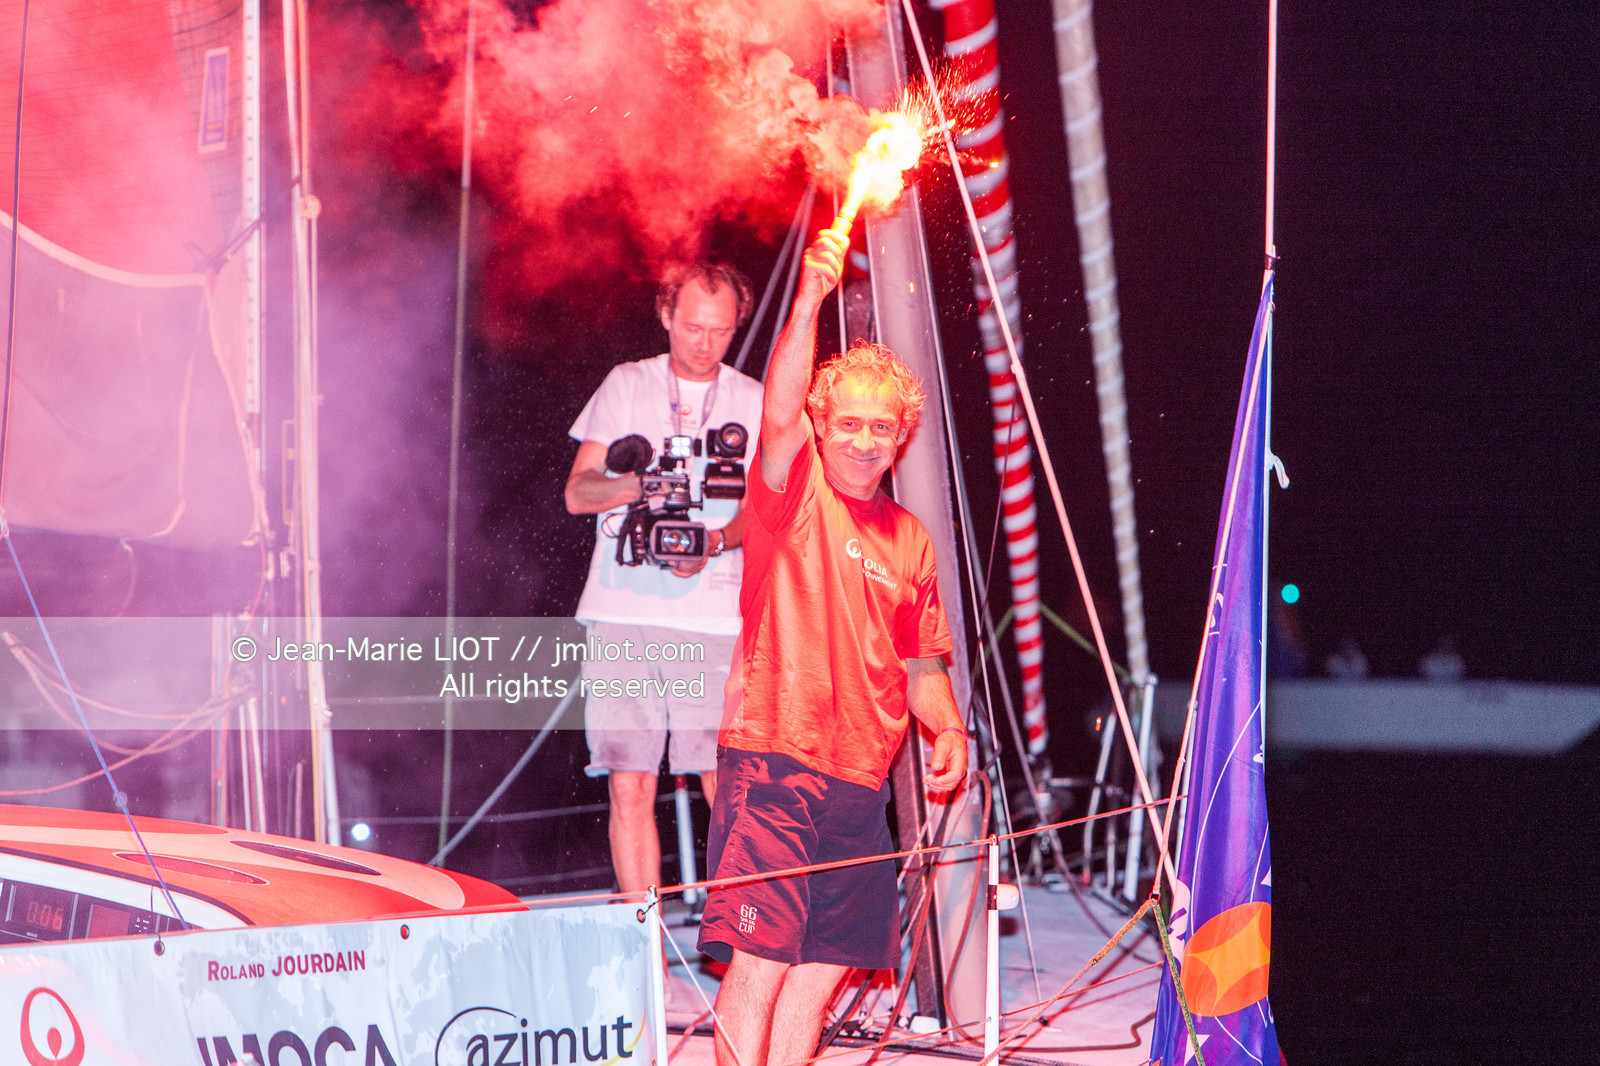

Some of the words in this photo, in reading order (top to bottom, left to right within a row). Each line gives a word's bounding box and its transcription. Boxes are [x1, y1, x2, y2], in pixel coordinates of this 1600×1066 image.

[861, 555, 888, 578] OLIA
[740, 904, 758, 921] 66
[271, 950, 367, 977] JOURDAIN
[466, 1014, 633, 1066] azimut
